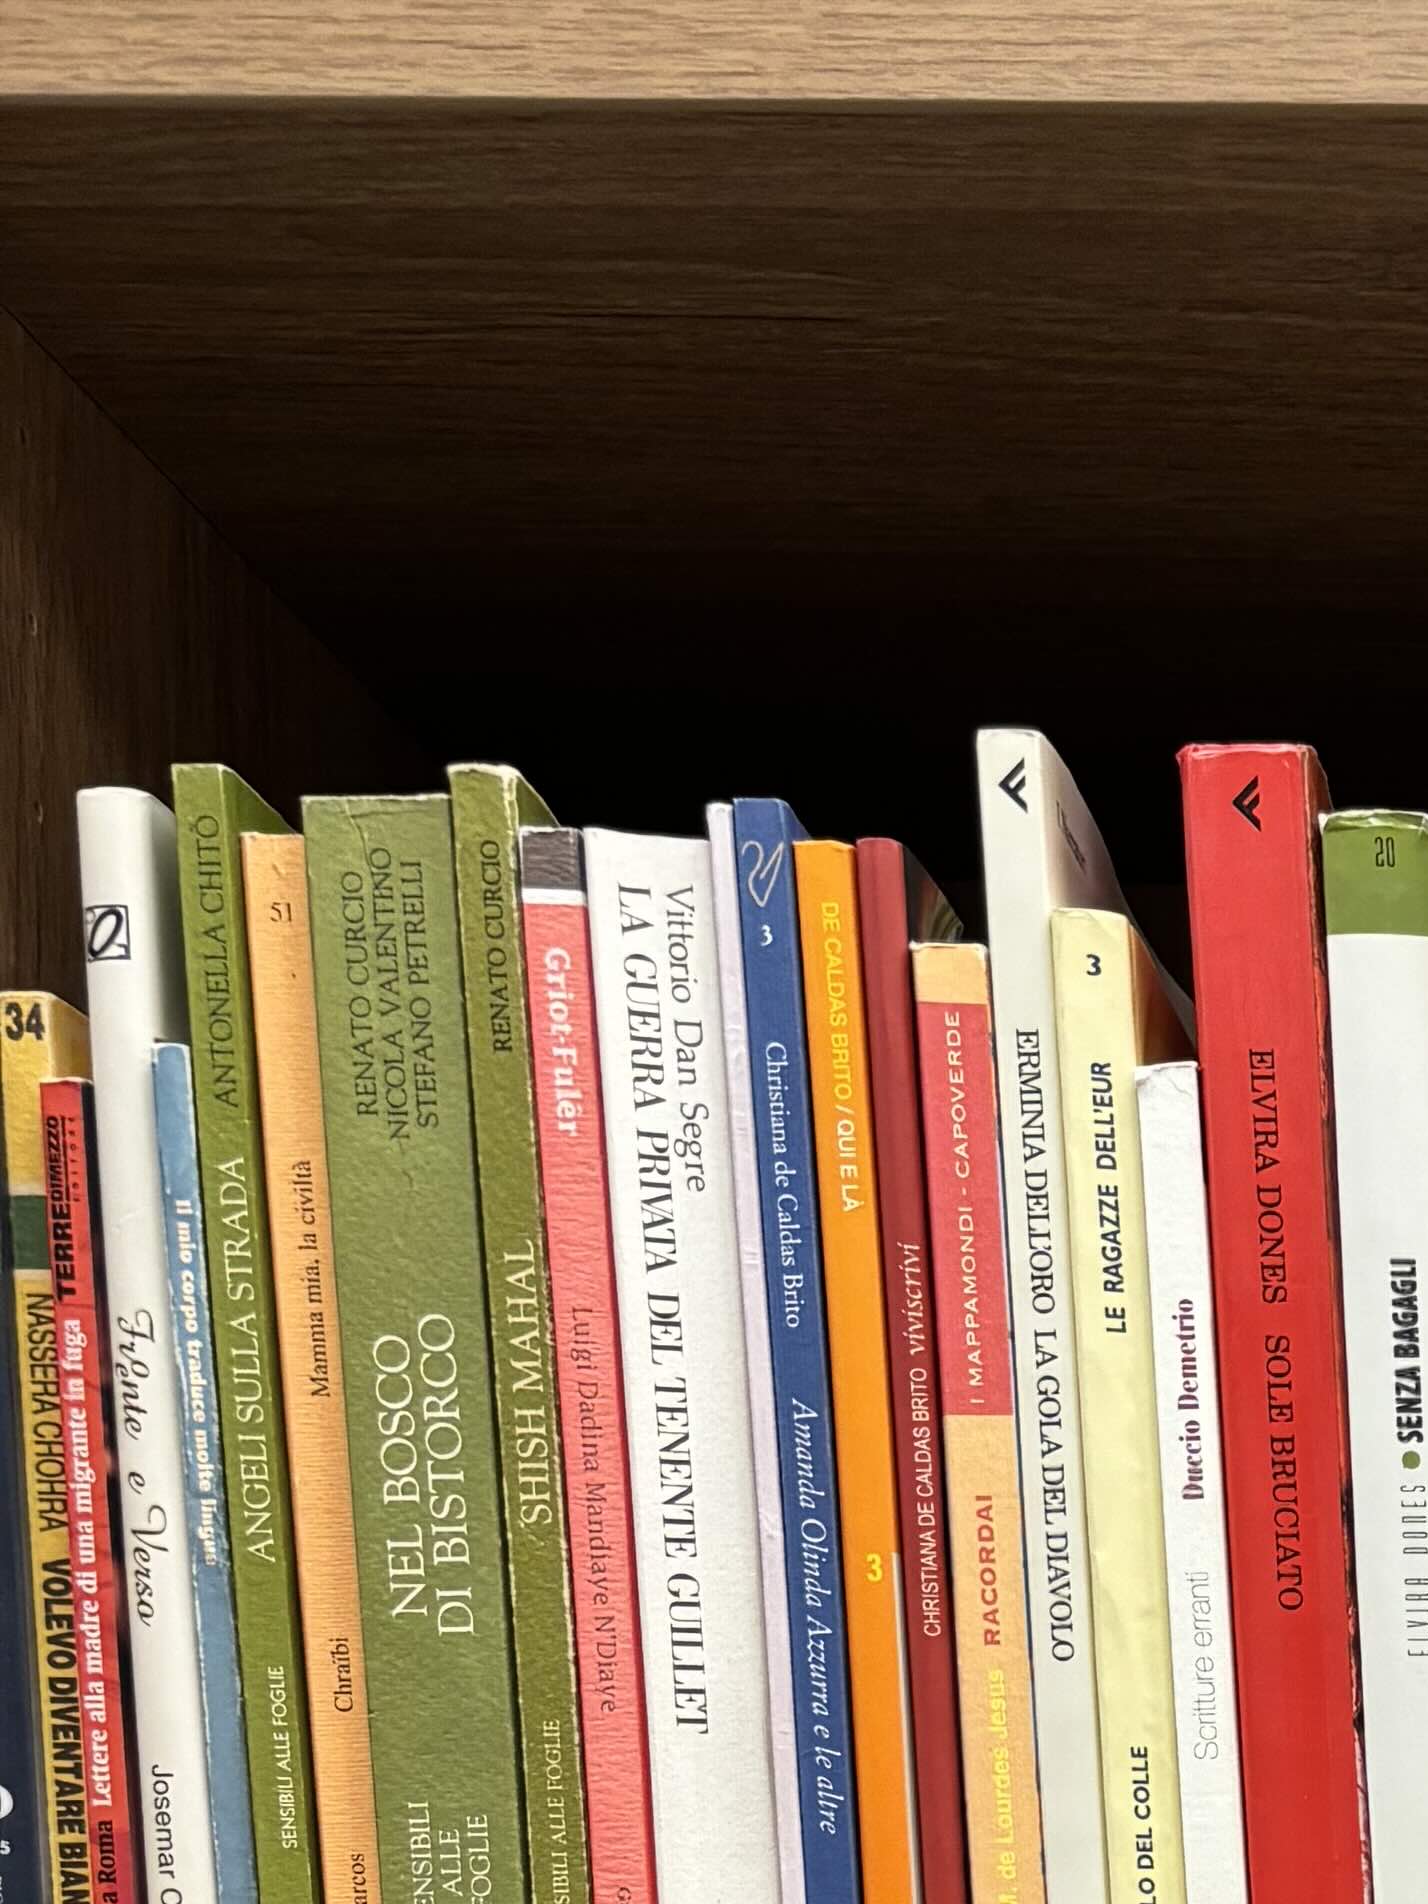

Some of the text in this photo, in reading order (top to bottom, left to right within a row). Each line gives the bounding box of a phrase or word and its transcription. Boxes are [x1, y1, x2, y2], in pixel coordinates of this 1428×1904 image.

[666, 885, 709, 1192] Vittorio Dan Segre
[27, 1294, 70, 1530] NASSERA CHOHRA
[618, 884, 708, 1734] LA GUERRA PRIVATA DEL TENENTE GUILLET
[1249, 1049, 1303, 1610] ELVIRA DONES SOLE BRUCIATO
[42, 1559, 76, 1669] VOLEVO
[372, 1335, 427, 1617] NEL BOSCO
[417, 1314, 474, 1636] DI BISTORCO
[48, 1677, 86, 1834] DIVENTARE
[151, 1764, 175, 1879] Josemar
